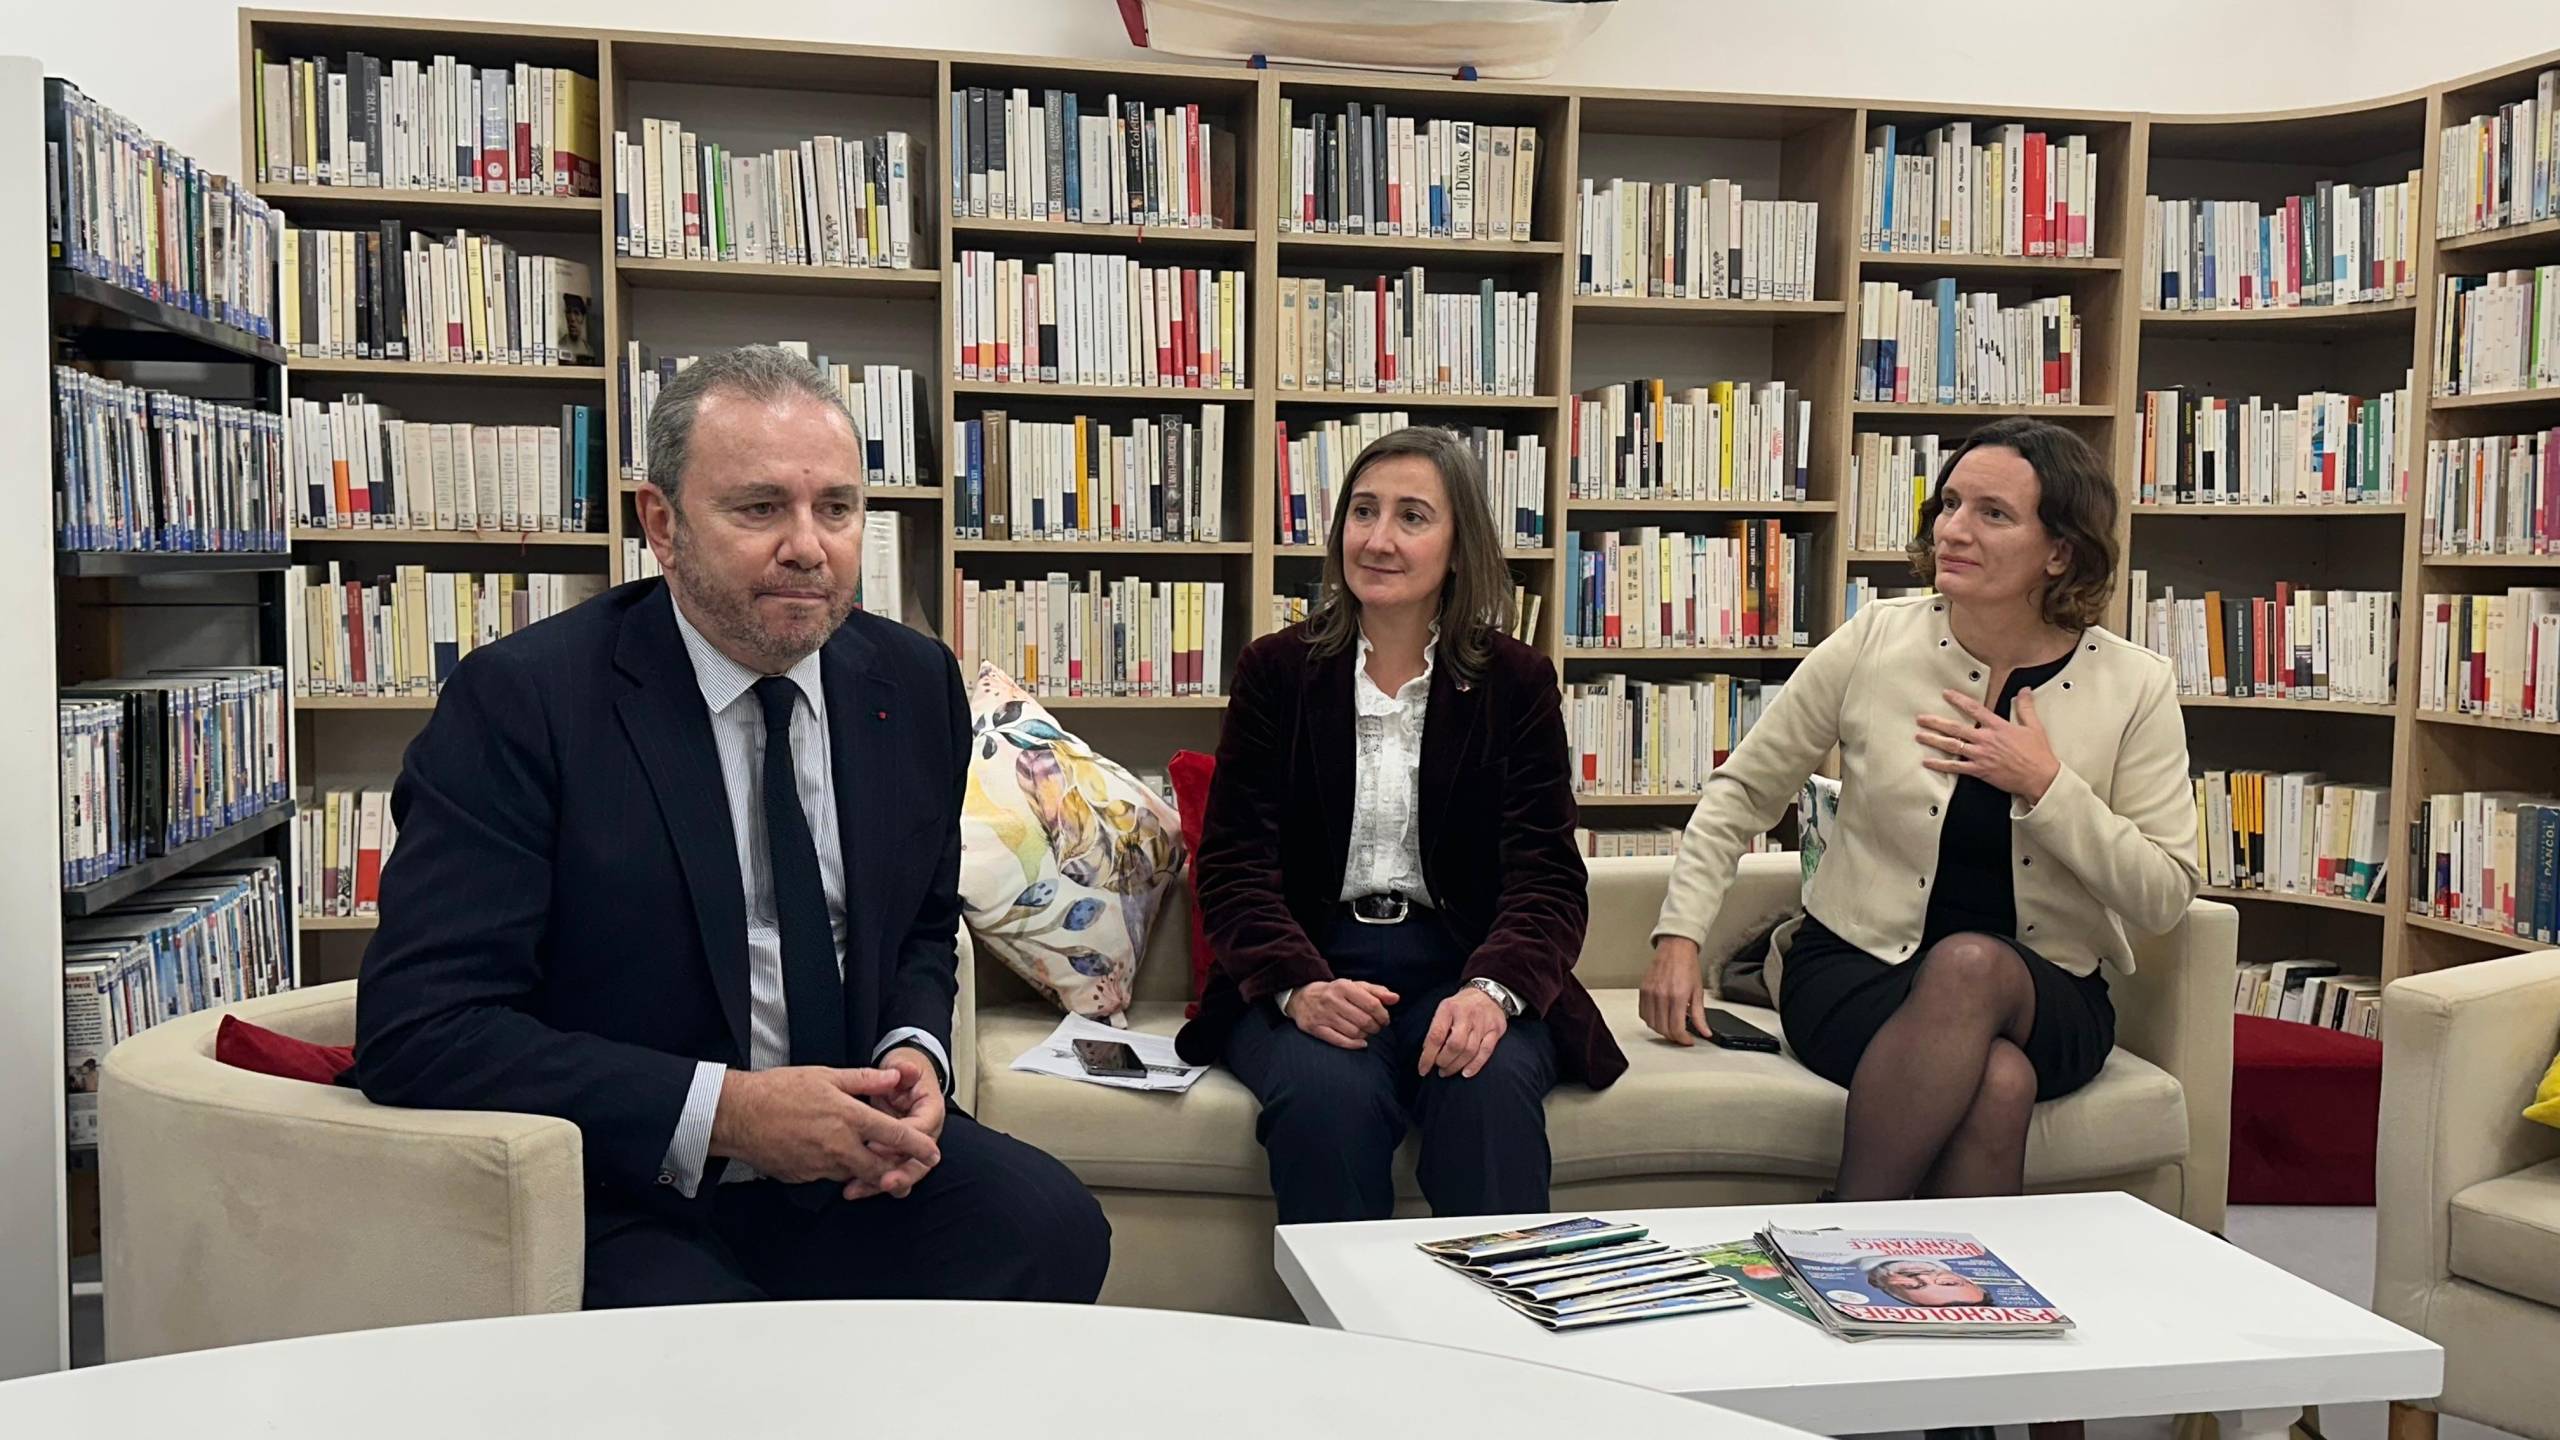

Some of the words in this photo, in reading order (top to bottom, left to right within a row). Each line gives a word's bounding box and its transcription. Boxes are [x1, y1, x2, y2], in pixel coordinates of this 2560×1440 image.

[366, 88, 377, 124] LIVRE
[1129, 109, 1141, 149] Colette
[1455, 151, 1471, 191] DUMAS
[2543, 821, 2556, 878] PANCOL
[1848, 1240, 1968, 1250] CONFIANCE
[1841, 1304, 2059, 1324] PSYCHOLOGIES
